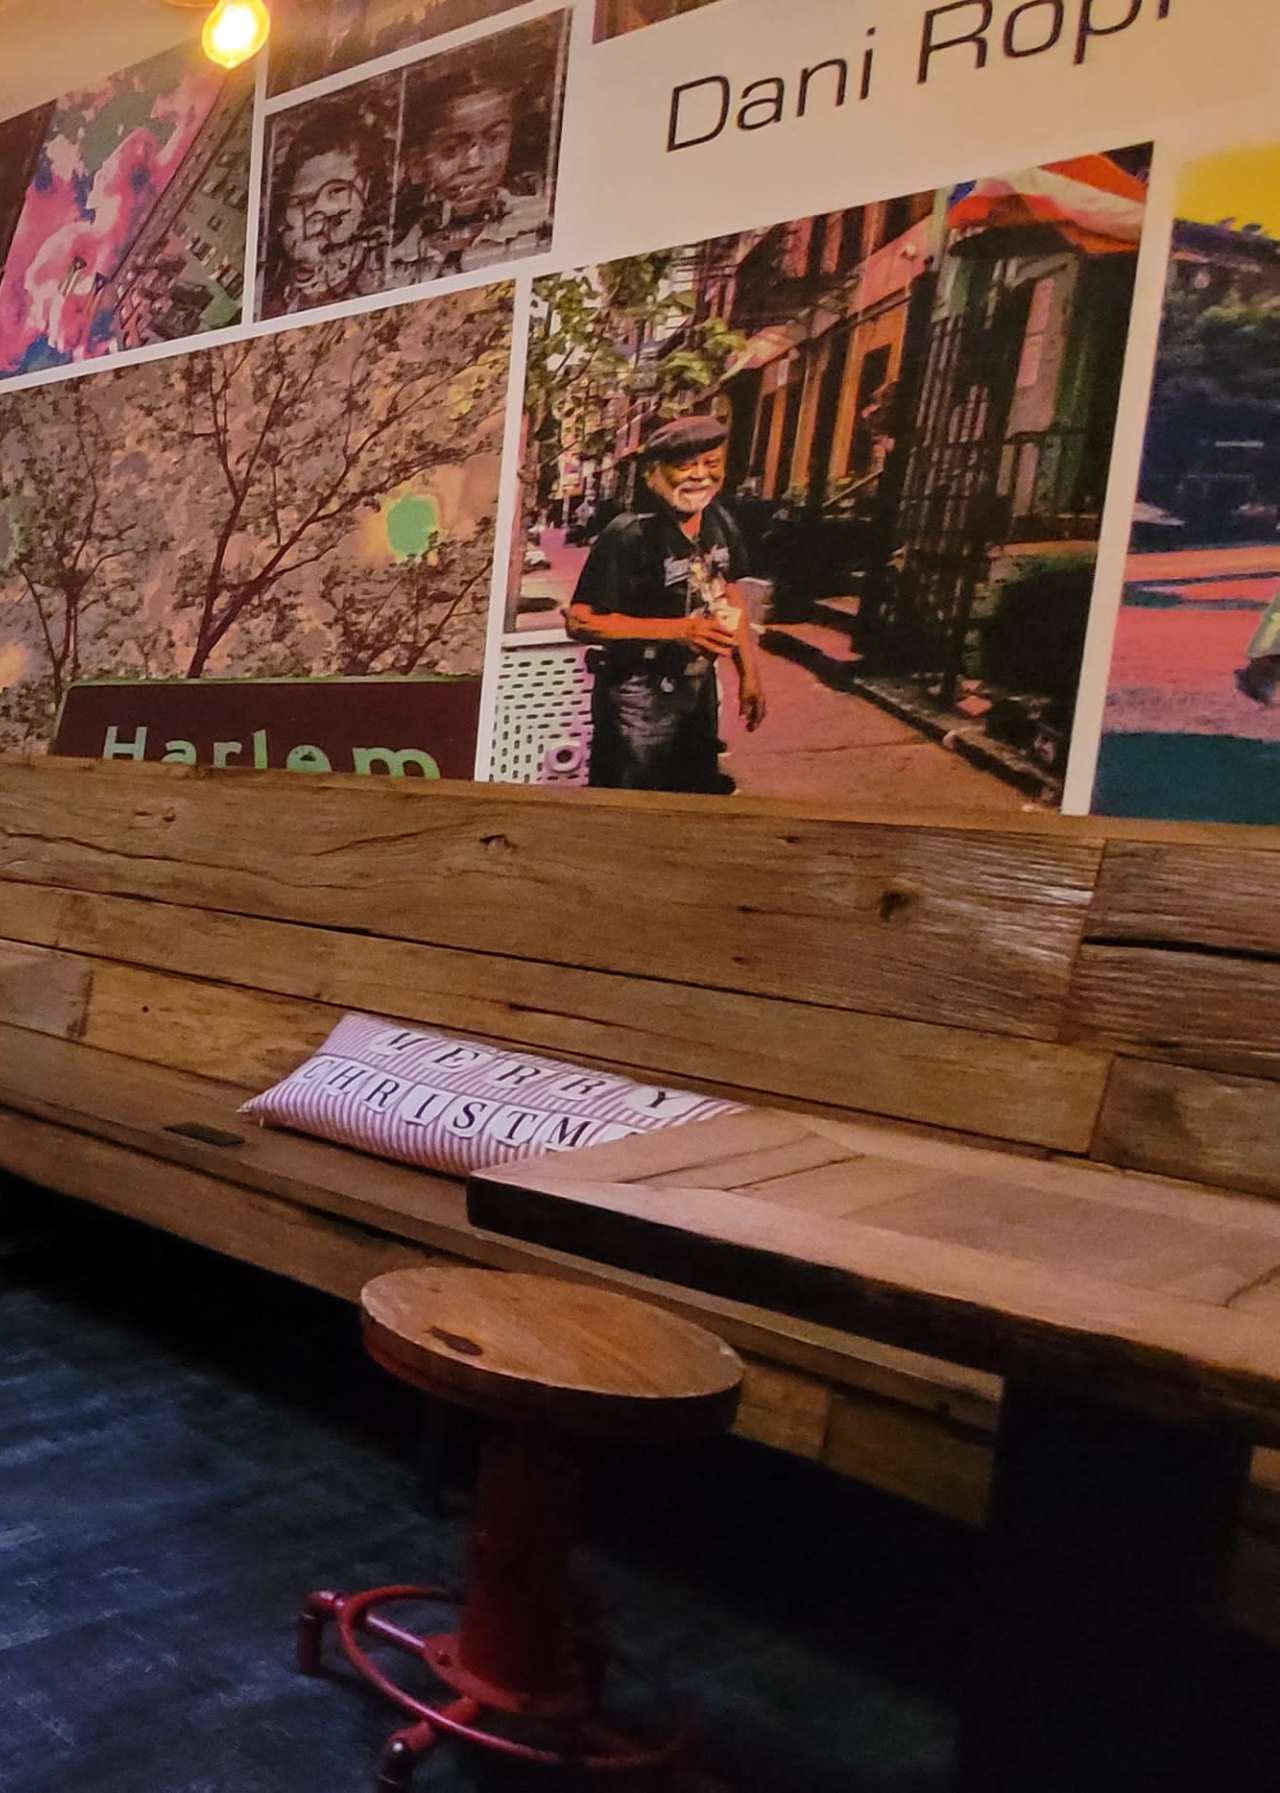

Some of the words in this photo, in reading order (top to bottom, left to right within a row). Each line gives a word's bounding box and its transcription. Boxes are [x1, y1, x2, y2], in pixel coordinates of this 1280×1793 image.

[666, 27, 876, 153] Dani
[300, 1058, 637, 1148] CHRISTM
[376, 1030, 685, 1109] MERRY
